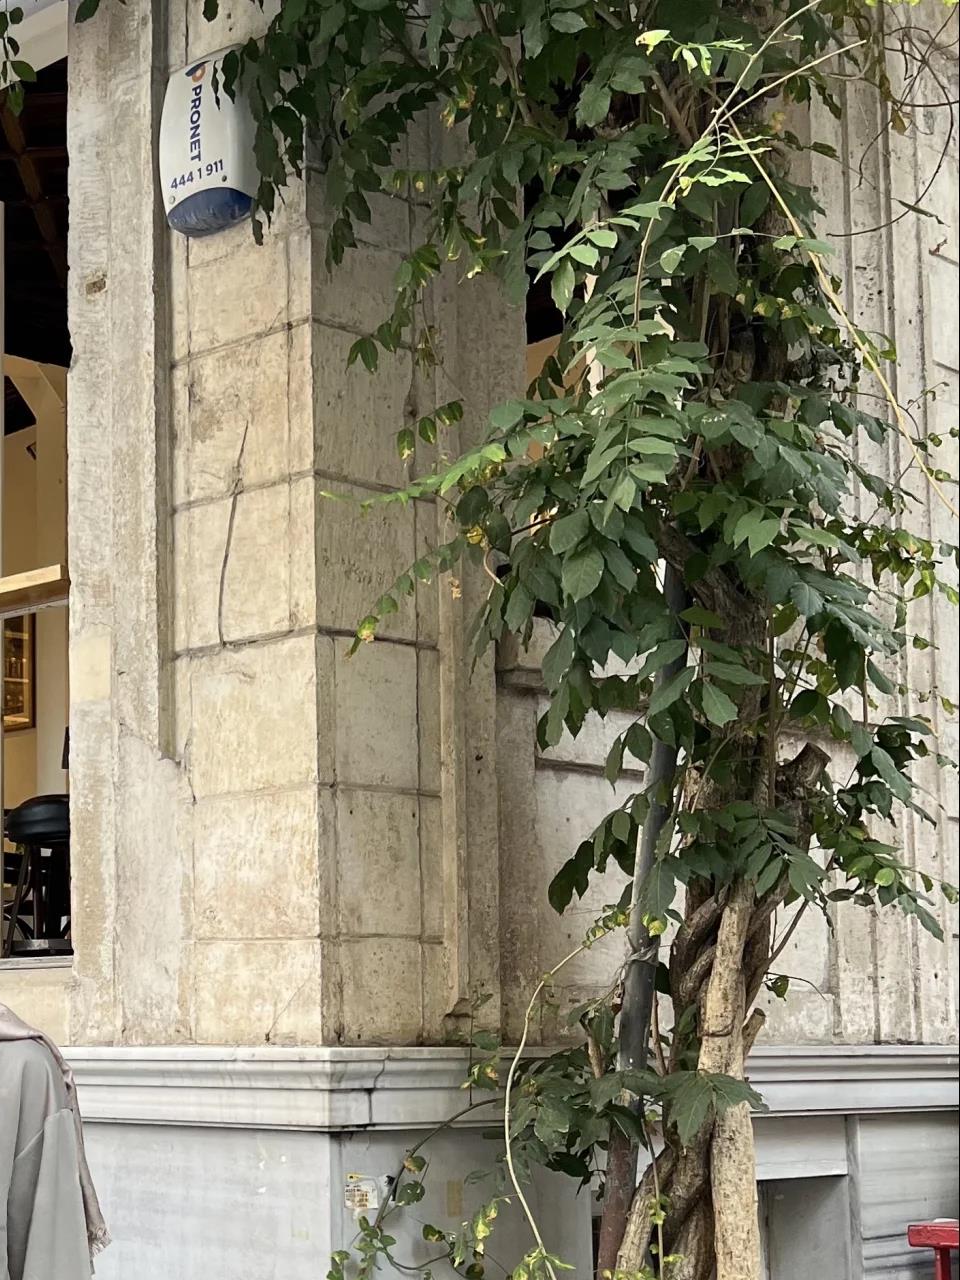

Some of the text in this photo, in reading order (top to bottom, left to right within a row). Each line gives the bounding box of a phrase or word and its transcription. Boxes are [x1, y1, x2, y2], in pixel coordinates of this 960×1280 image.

[189, 83, 203, 162] PRONET
[170, 172, 194, 190] 444
[205, 158, 224, 177] 911
